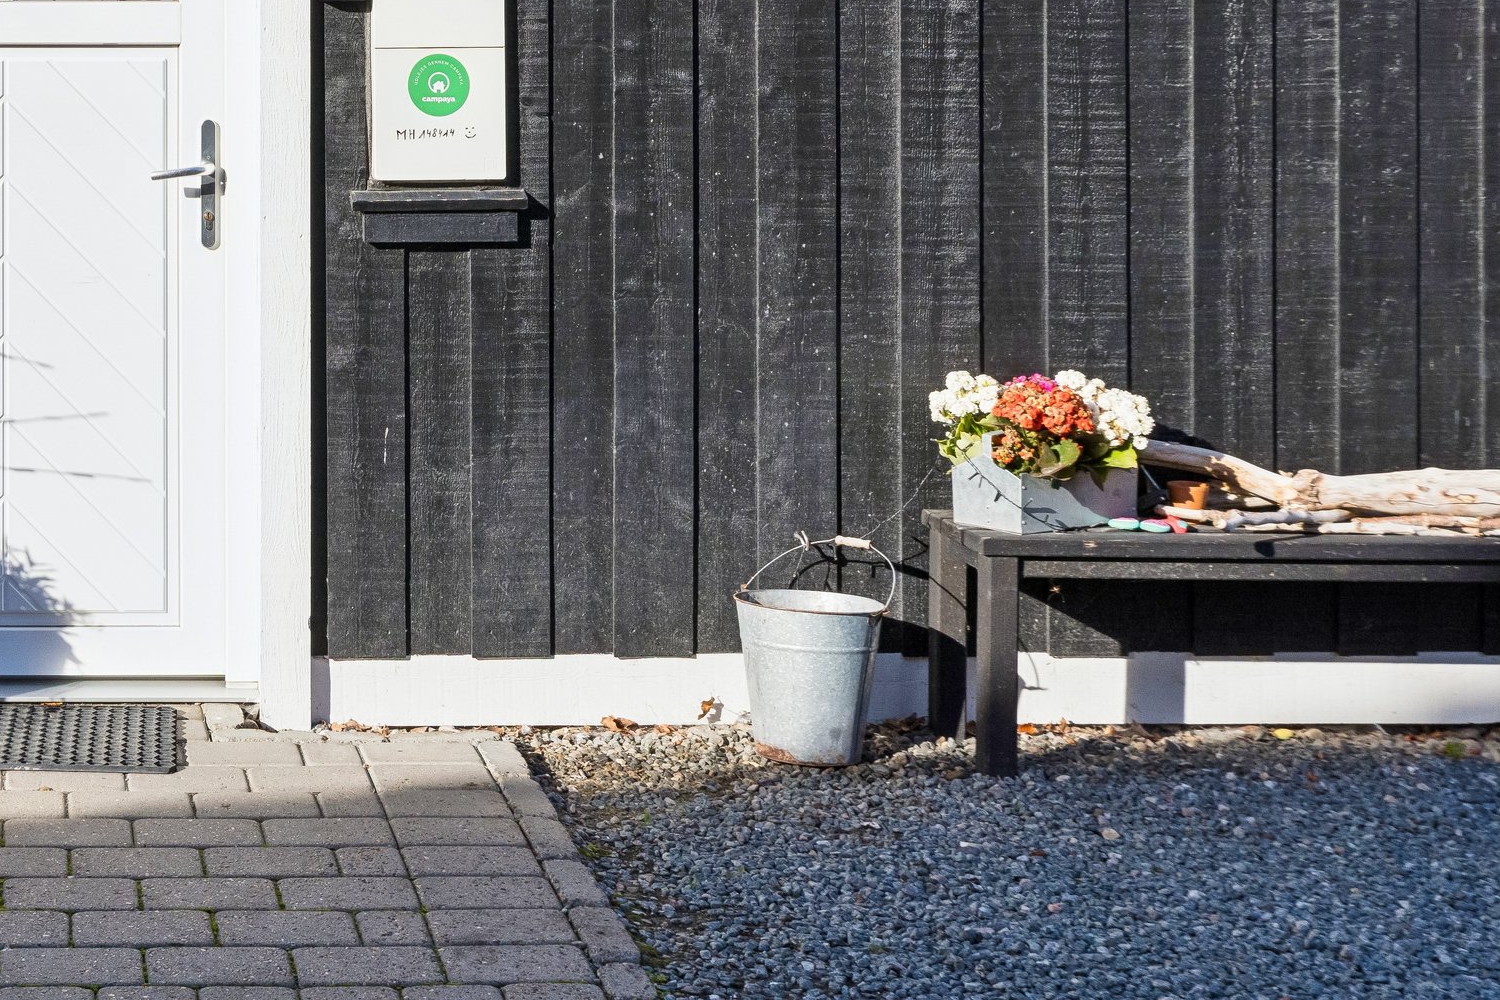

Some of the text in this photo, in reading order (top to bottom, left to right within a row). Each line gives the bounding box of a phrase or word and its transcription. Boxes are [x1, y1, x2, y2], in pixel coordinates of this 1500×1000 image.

[449, 63, 464, 86] CAMPAYA
[421, 96, 456, 104] campaya
[396, 129, 415, 140] MH
